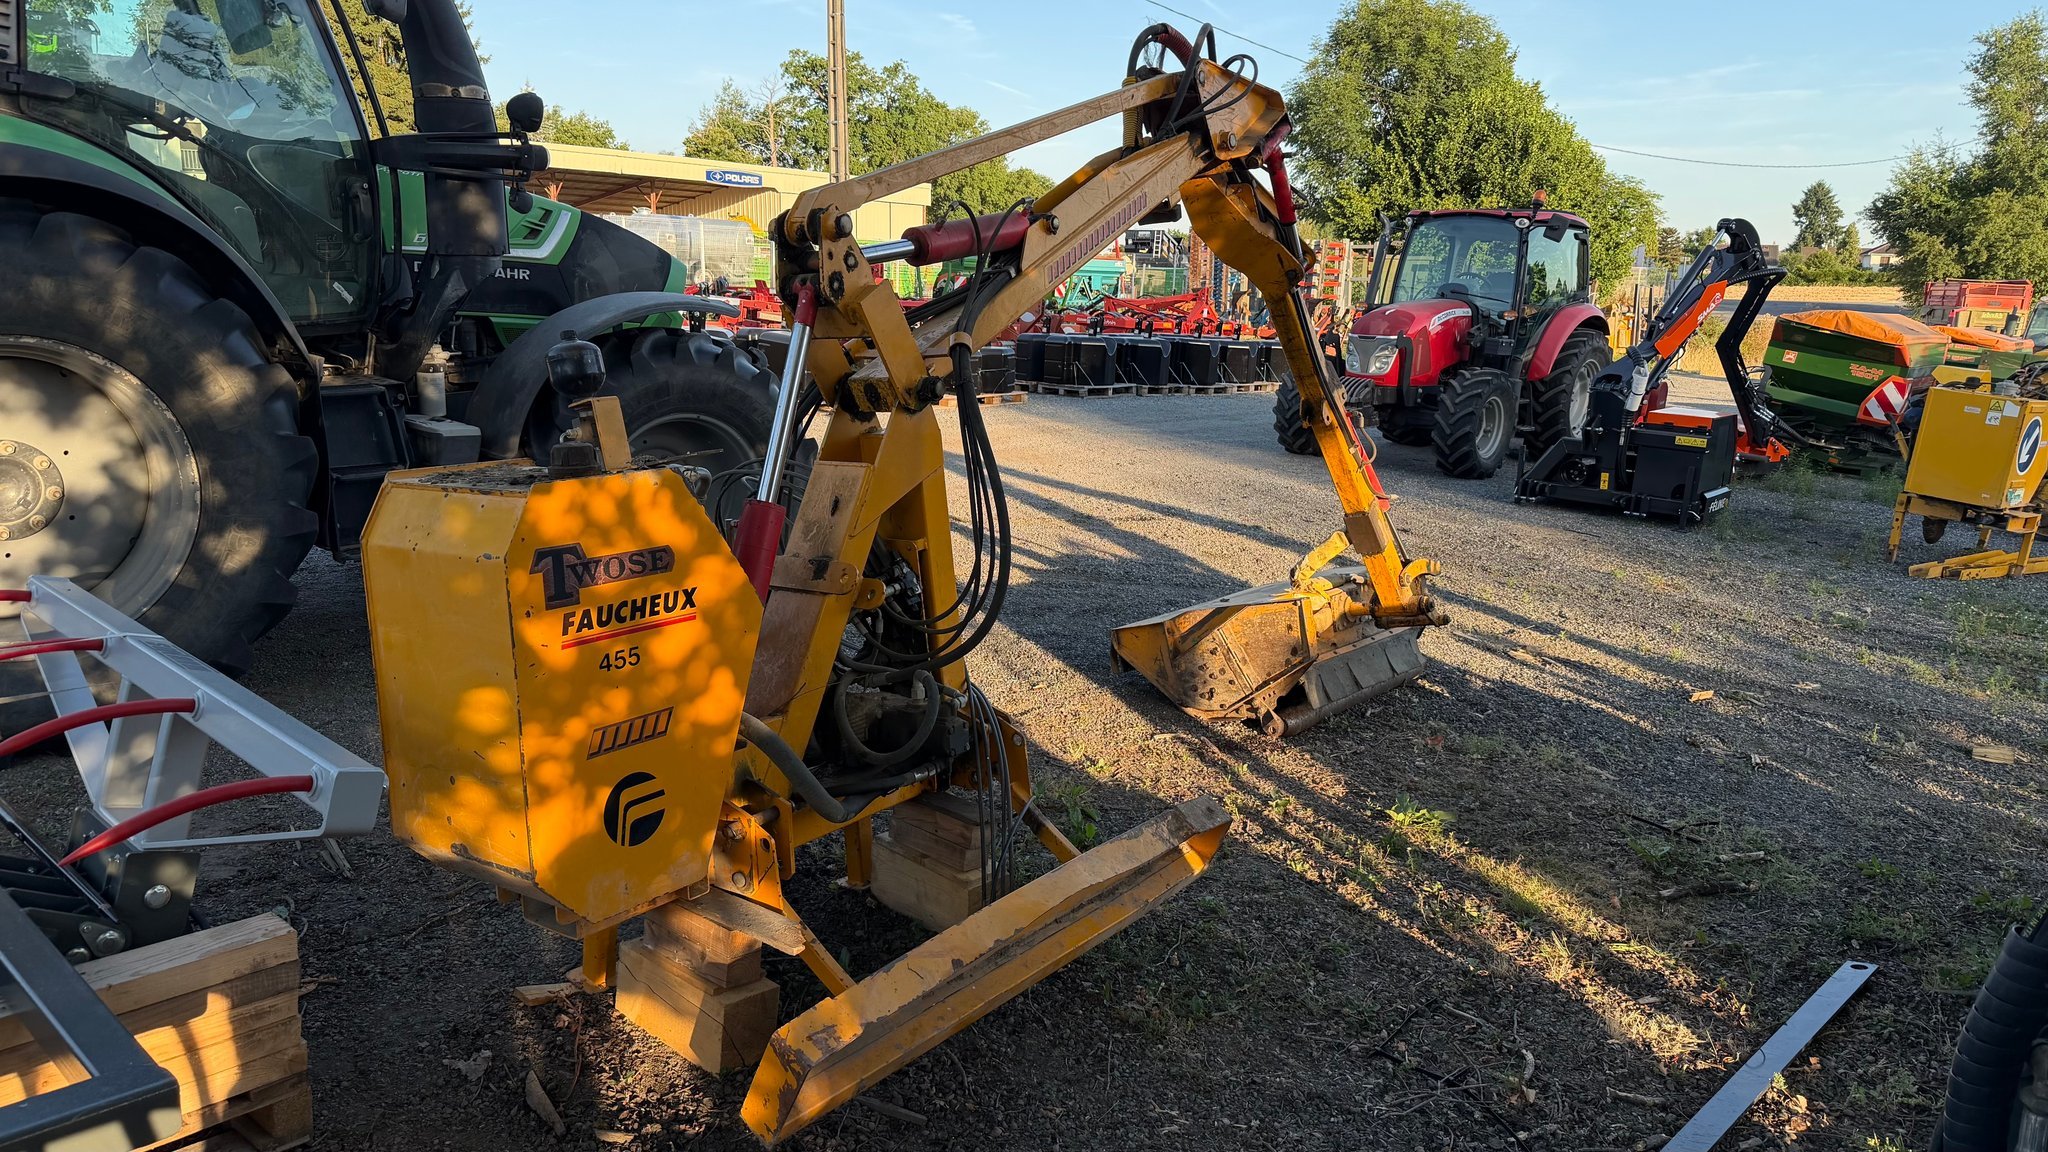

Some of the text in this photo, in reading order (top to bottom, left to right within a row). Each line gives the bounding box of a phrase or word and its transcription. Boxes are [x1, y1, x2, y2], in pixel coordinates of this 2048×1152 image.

[725, 173, 760, 184] POLARIS
[561, 587, 698, 637] FAUCHEUX
[598, 646, 641, 673] 455
